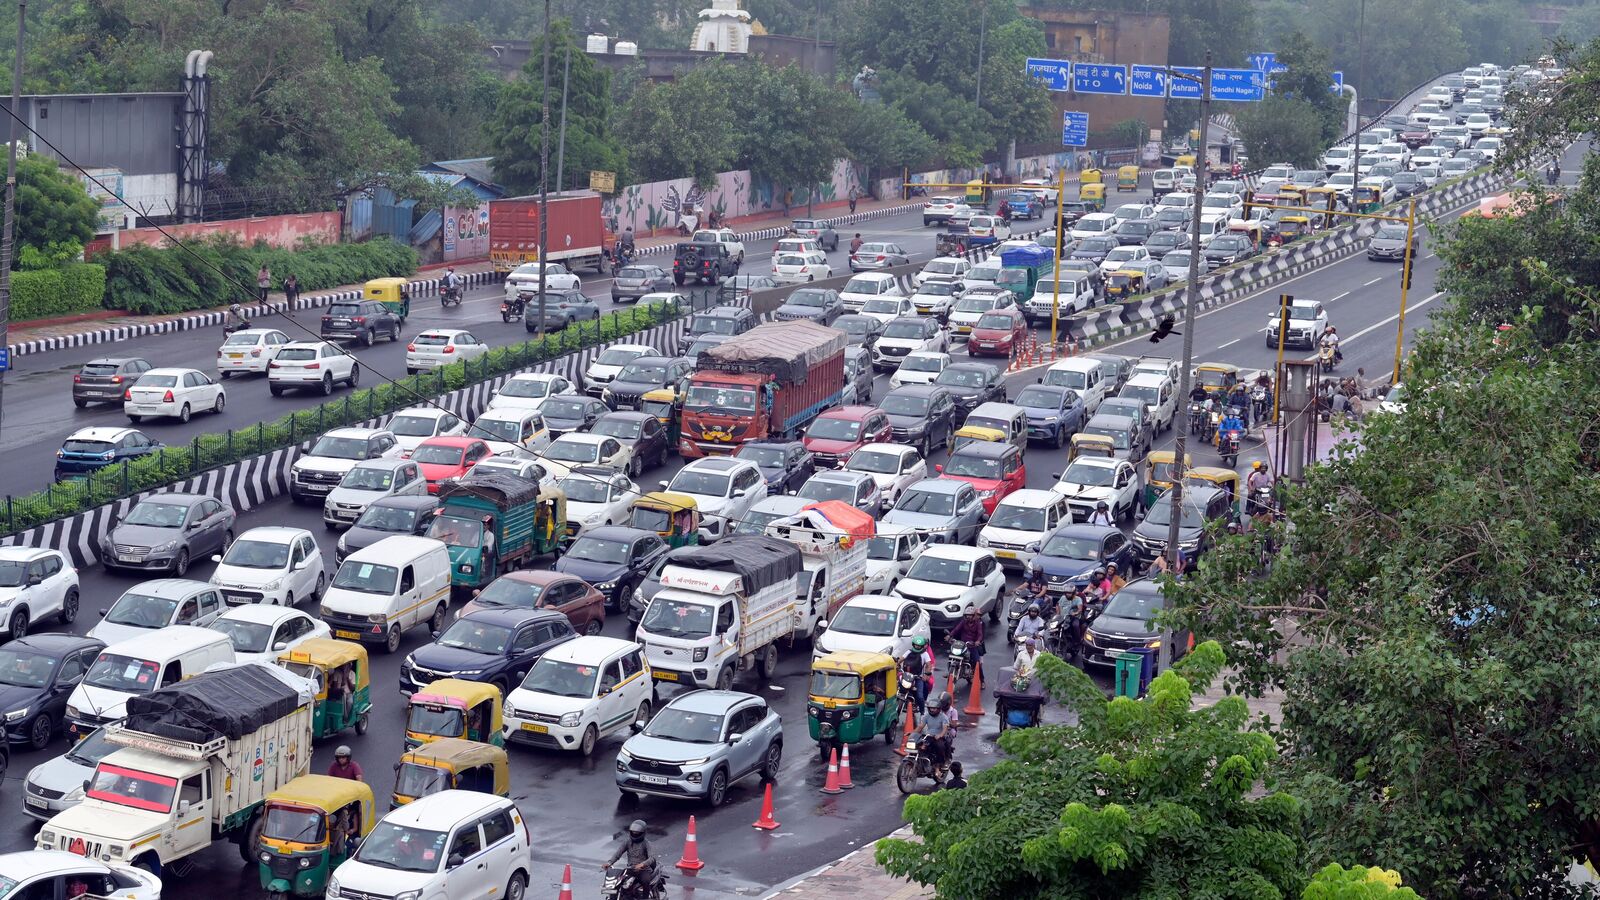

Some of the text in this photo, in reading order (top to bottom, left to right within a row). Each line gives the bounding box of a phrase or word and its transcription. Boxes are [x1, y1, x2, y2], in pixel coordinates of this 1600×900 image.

[1029, 64, 1058, 74] राजघाट
[1076, 67, 1088, 77] आई
[1091, 67, 1099, 77] टी
[1133, 69, 1152, 79] नोएडा
[1133, 82, 1153, 90] Noida
[1172, 83, 1198, 92] Ashram
[1236, 87, 1254, 95] Nagar
